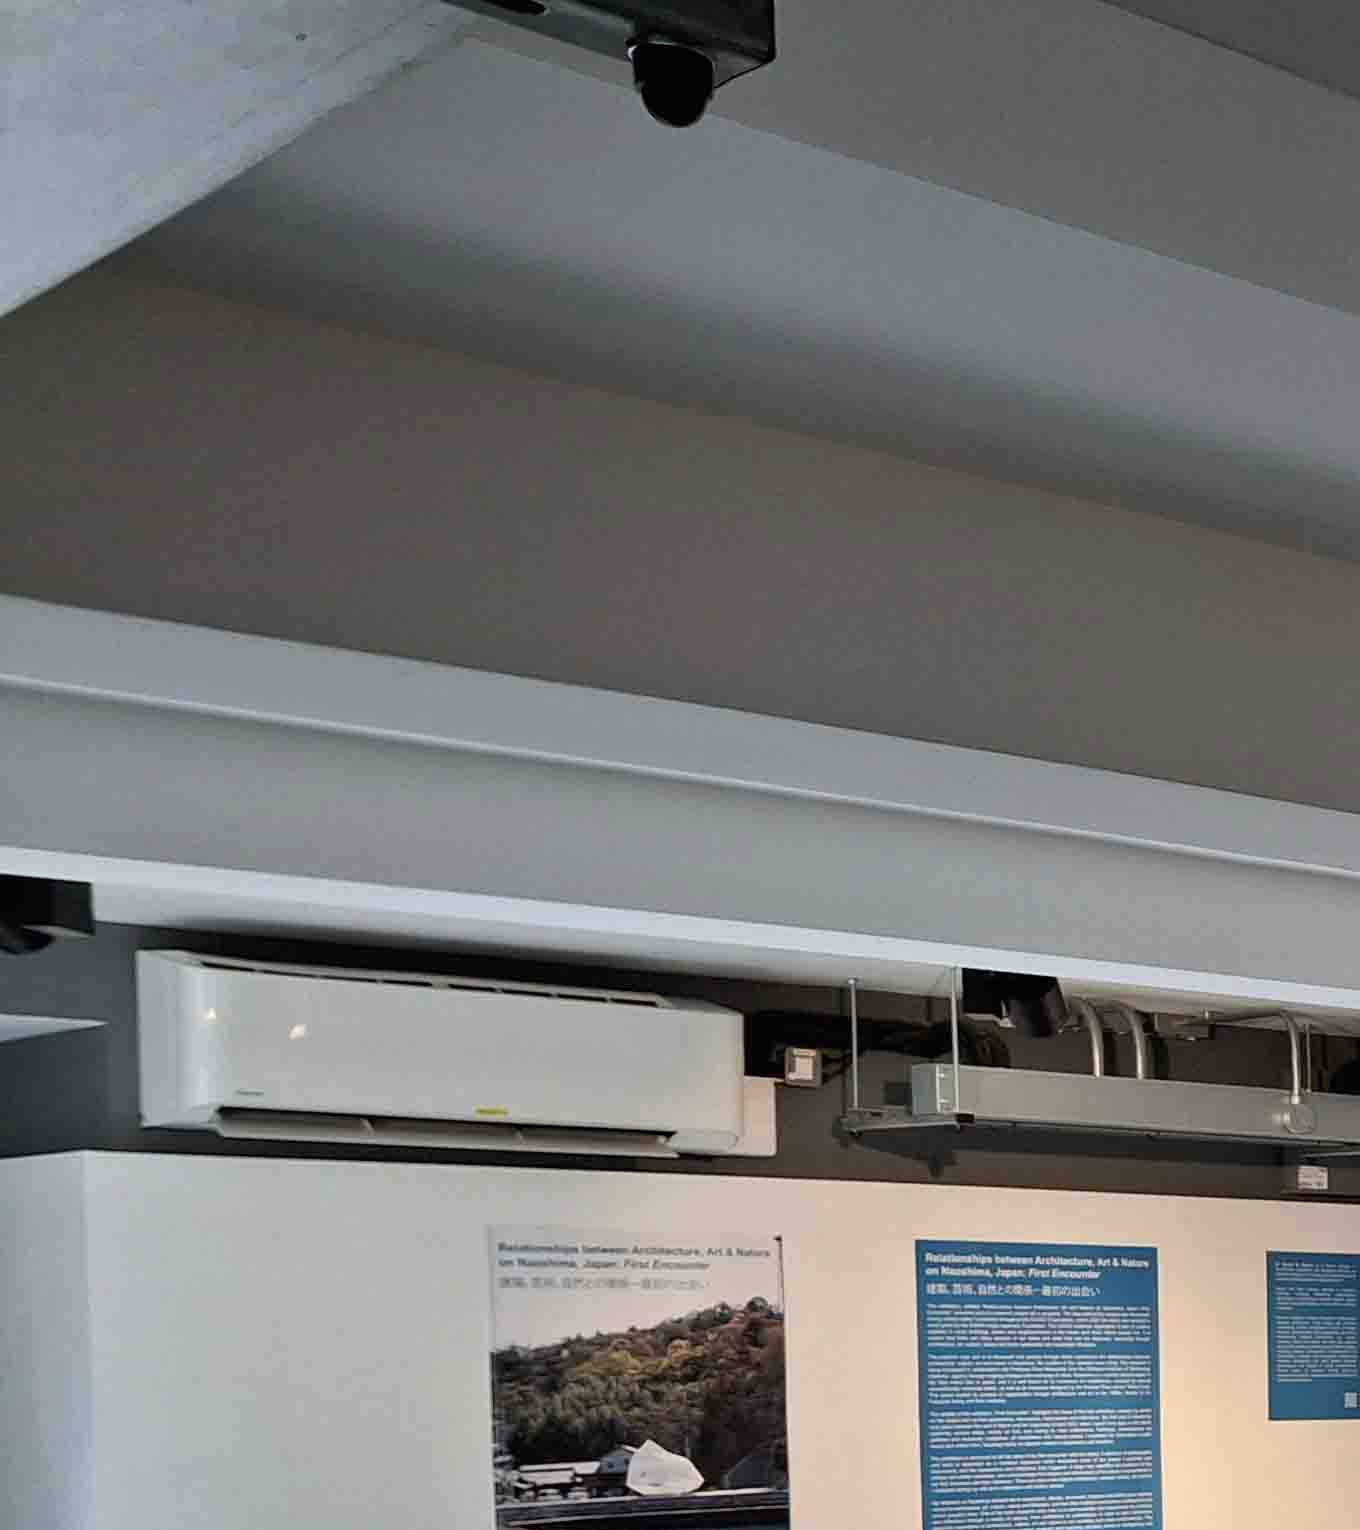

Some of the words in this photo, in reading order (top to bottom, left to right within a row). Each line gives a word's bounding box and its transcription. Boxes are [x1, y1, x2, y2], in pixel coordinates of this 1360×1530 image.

[707, 1248, 723, 1257] Art
[926, 1252, 993, 1266] Relationships
[994, 1253, 1033, 1265] between
[1097, 1257, 1111, 1267] Art
[1121, 1257, 1150, 1268] Nature
[1028, 1267, 1051, 1279] First
[1052, 1268, 1102, 1279] Encounter
